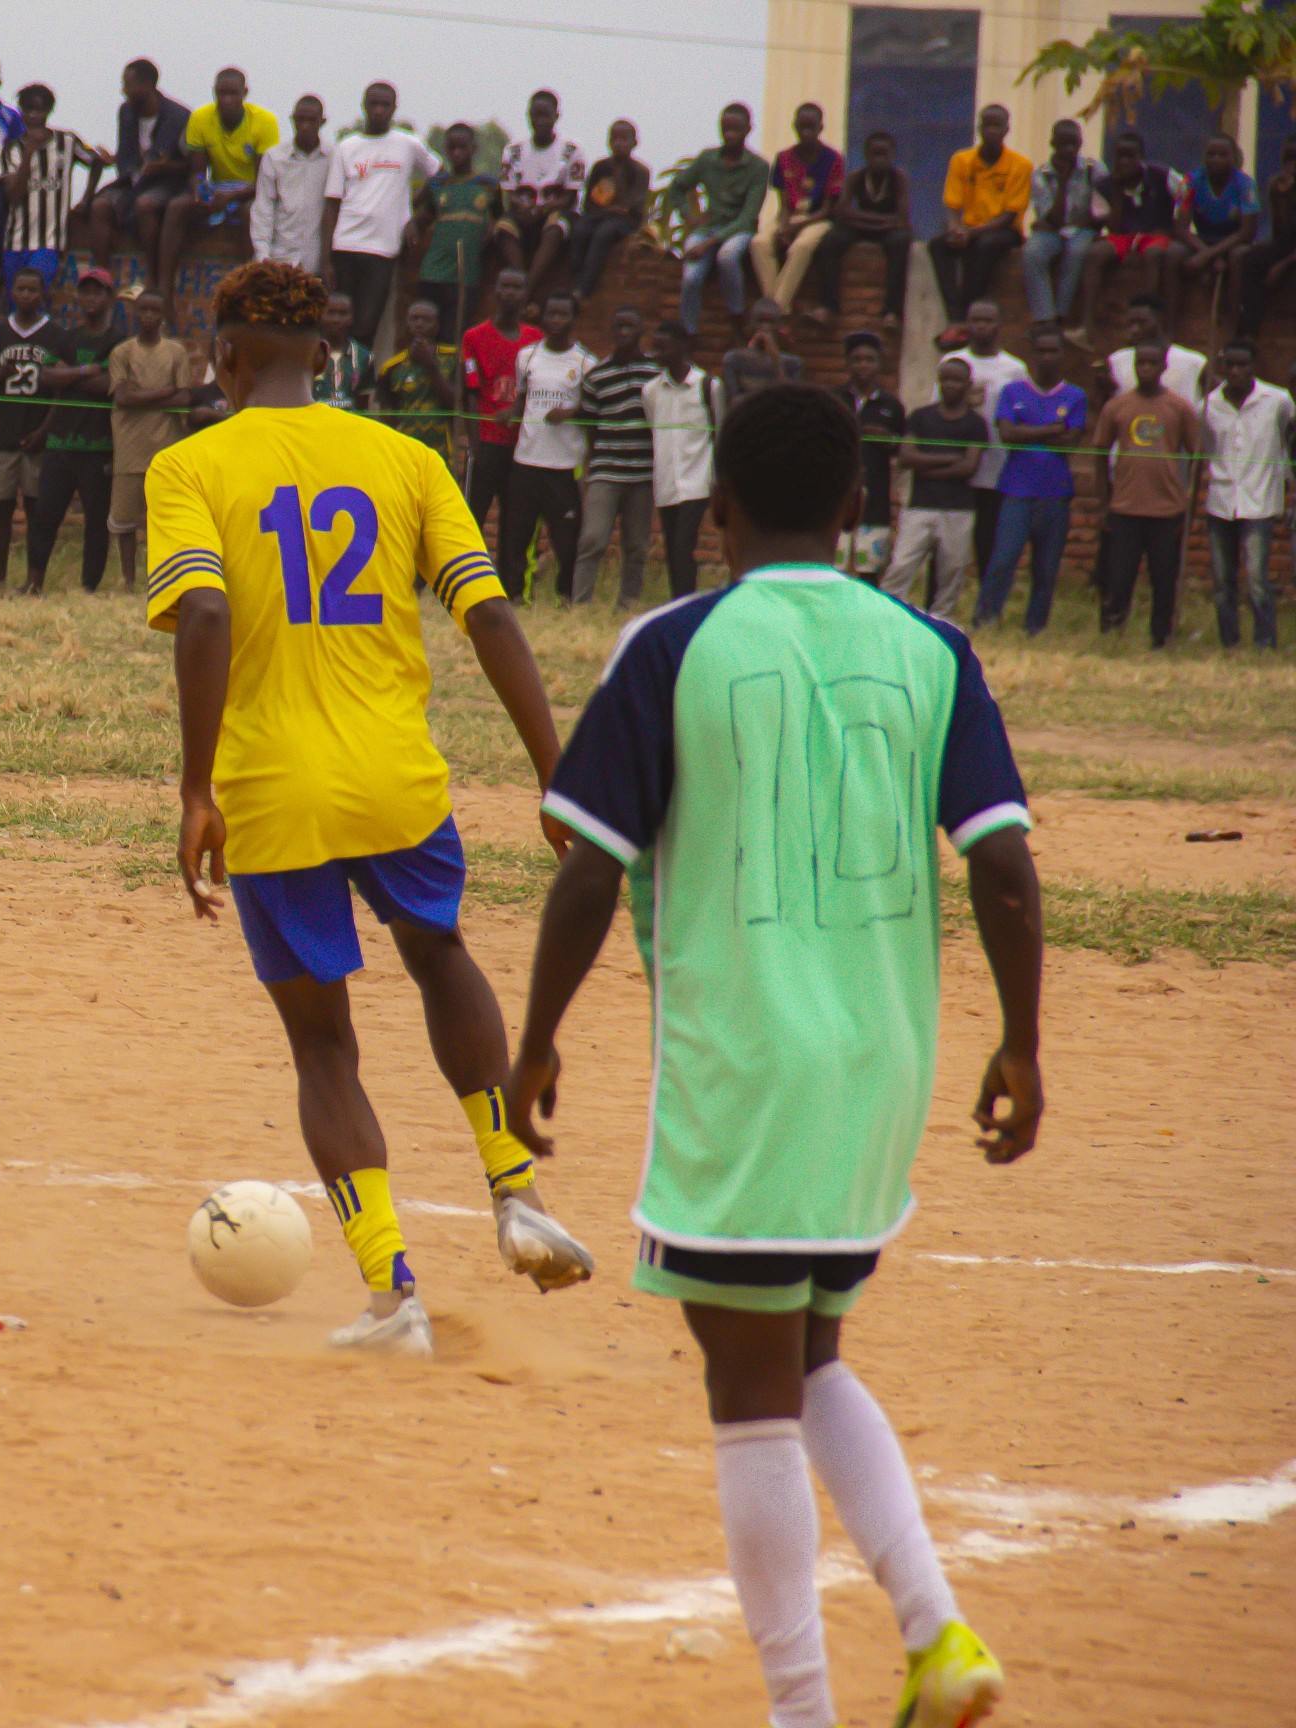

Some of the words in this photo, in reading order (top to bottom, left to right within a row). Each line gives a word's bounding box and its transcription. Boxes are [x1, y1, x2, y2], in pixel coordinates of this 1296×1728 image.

[6, 362, 39, 396] 23
[259, 485, 383, 625] 12
[730, 671, 916, 930] 10
